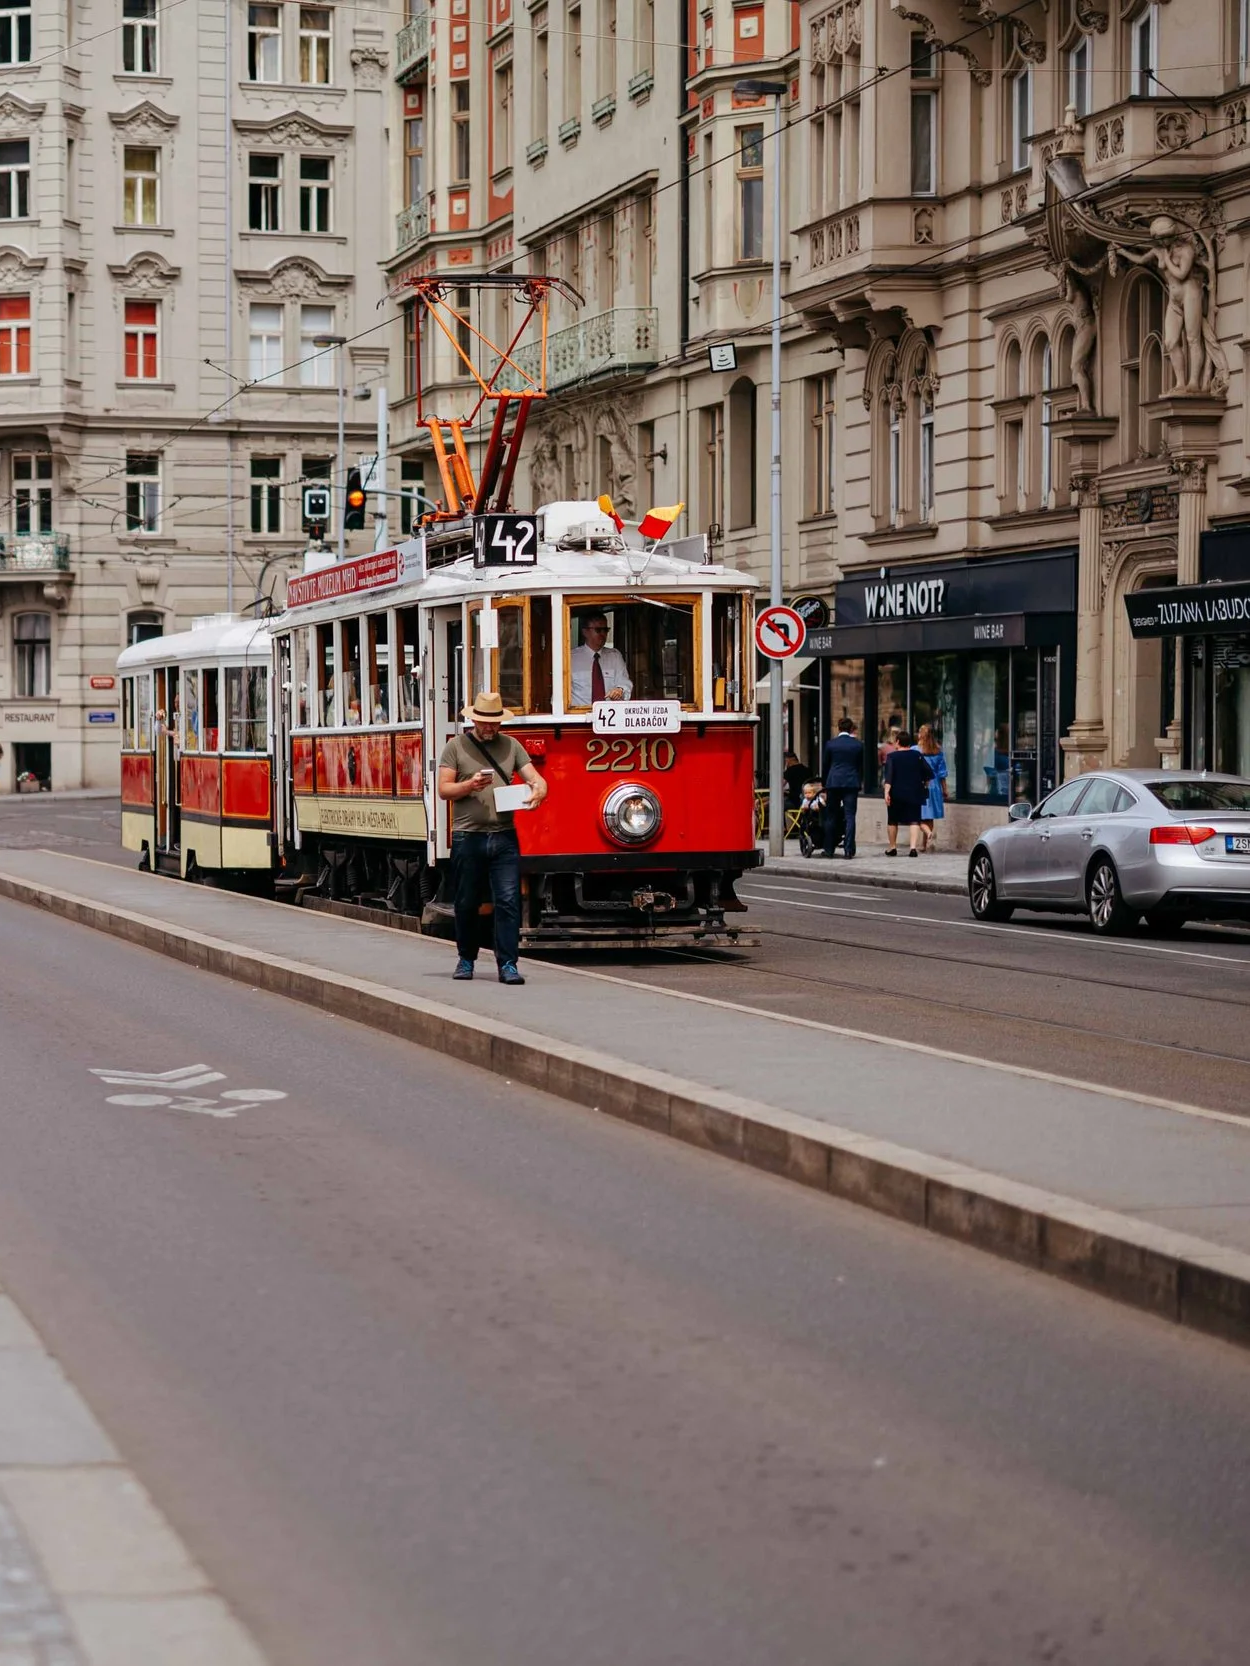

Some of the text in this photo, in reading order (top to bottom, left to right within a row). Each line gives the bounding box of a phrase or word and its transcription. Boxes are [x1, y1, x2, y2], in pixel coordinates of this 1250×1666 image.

[475, 522, 485, 563] 42
[491, 520, 534, 562] 42
[317, 571, 341, 597] MUZEUM
[342, 567, 357, 591] MHD
[907, 579, 944, 616] NOT?
[1157, 602, 1204, 625] ZUZANA
[974, 624, 1004, 640] WINE BAR
[809, 636, 832, 650] WINE BAR
[4, 712, 56, 723] RESTAURANT
[598, 708, 616, 727] 42
[625, 706, 668, 715] OKRUŽNÍ JÍZDA
[625, 716, 668, 727] DLABAČOV
[586, 738, 675, 772] 2210
